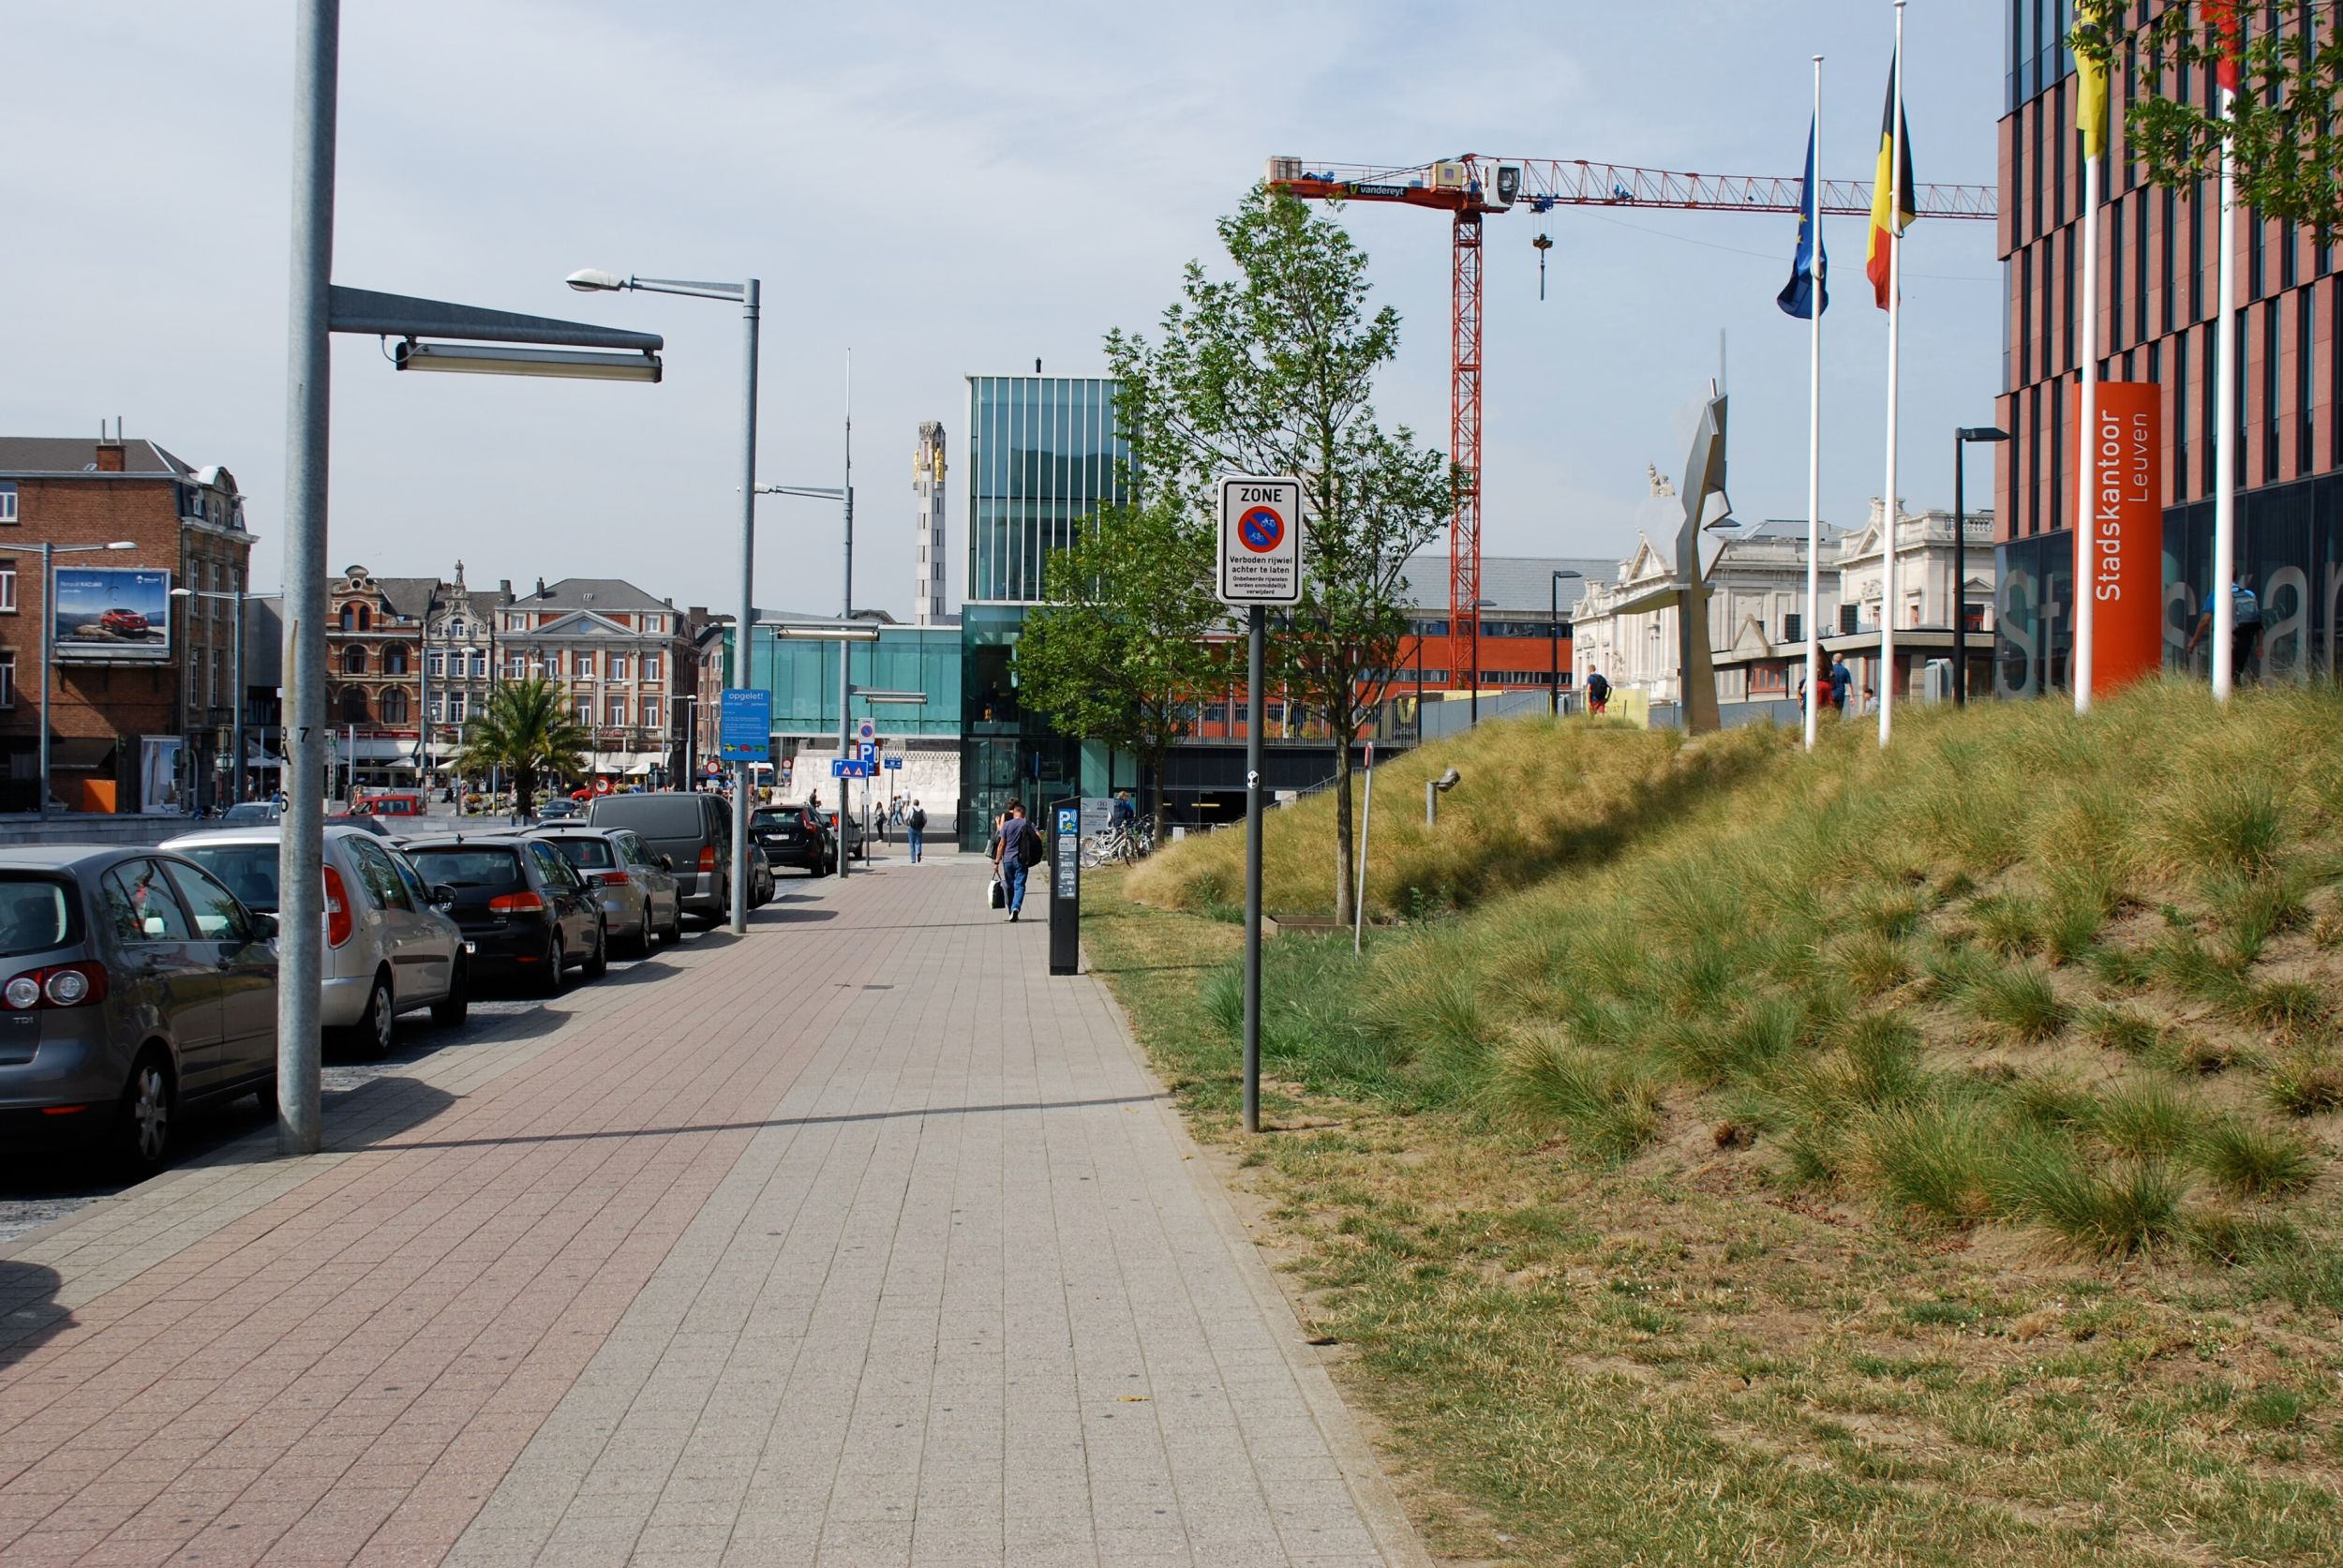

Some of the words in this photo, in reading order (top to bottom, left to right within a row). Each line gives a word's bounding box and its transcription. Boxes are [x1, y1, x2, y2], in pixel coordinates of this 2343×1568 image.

[1360, 186, 1404, 197] vandereyt
[2128, 413, 2148, 502] Leuven
[1240, 487, 1283, 502] ZONE
[2096, 410, 2121, 601] Stadskantoor
[1268, 557, 1292, 565] rijwiel
[1231, 565, 1258, 574] achter
[728, 692, 764, 701] opgelet!
